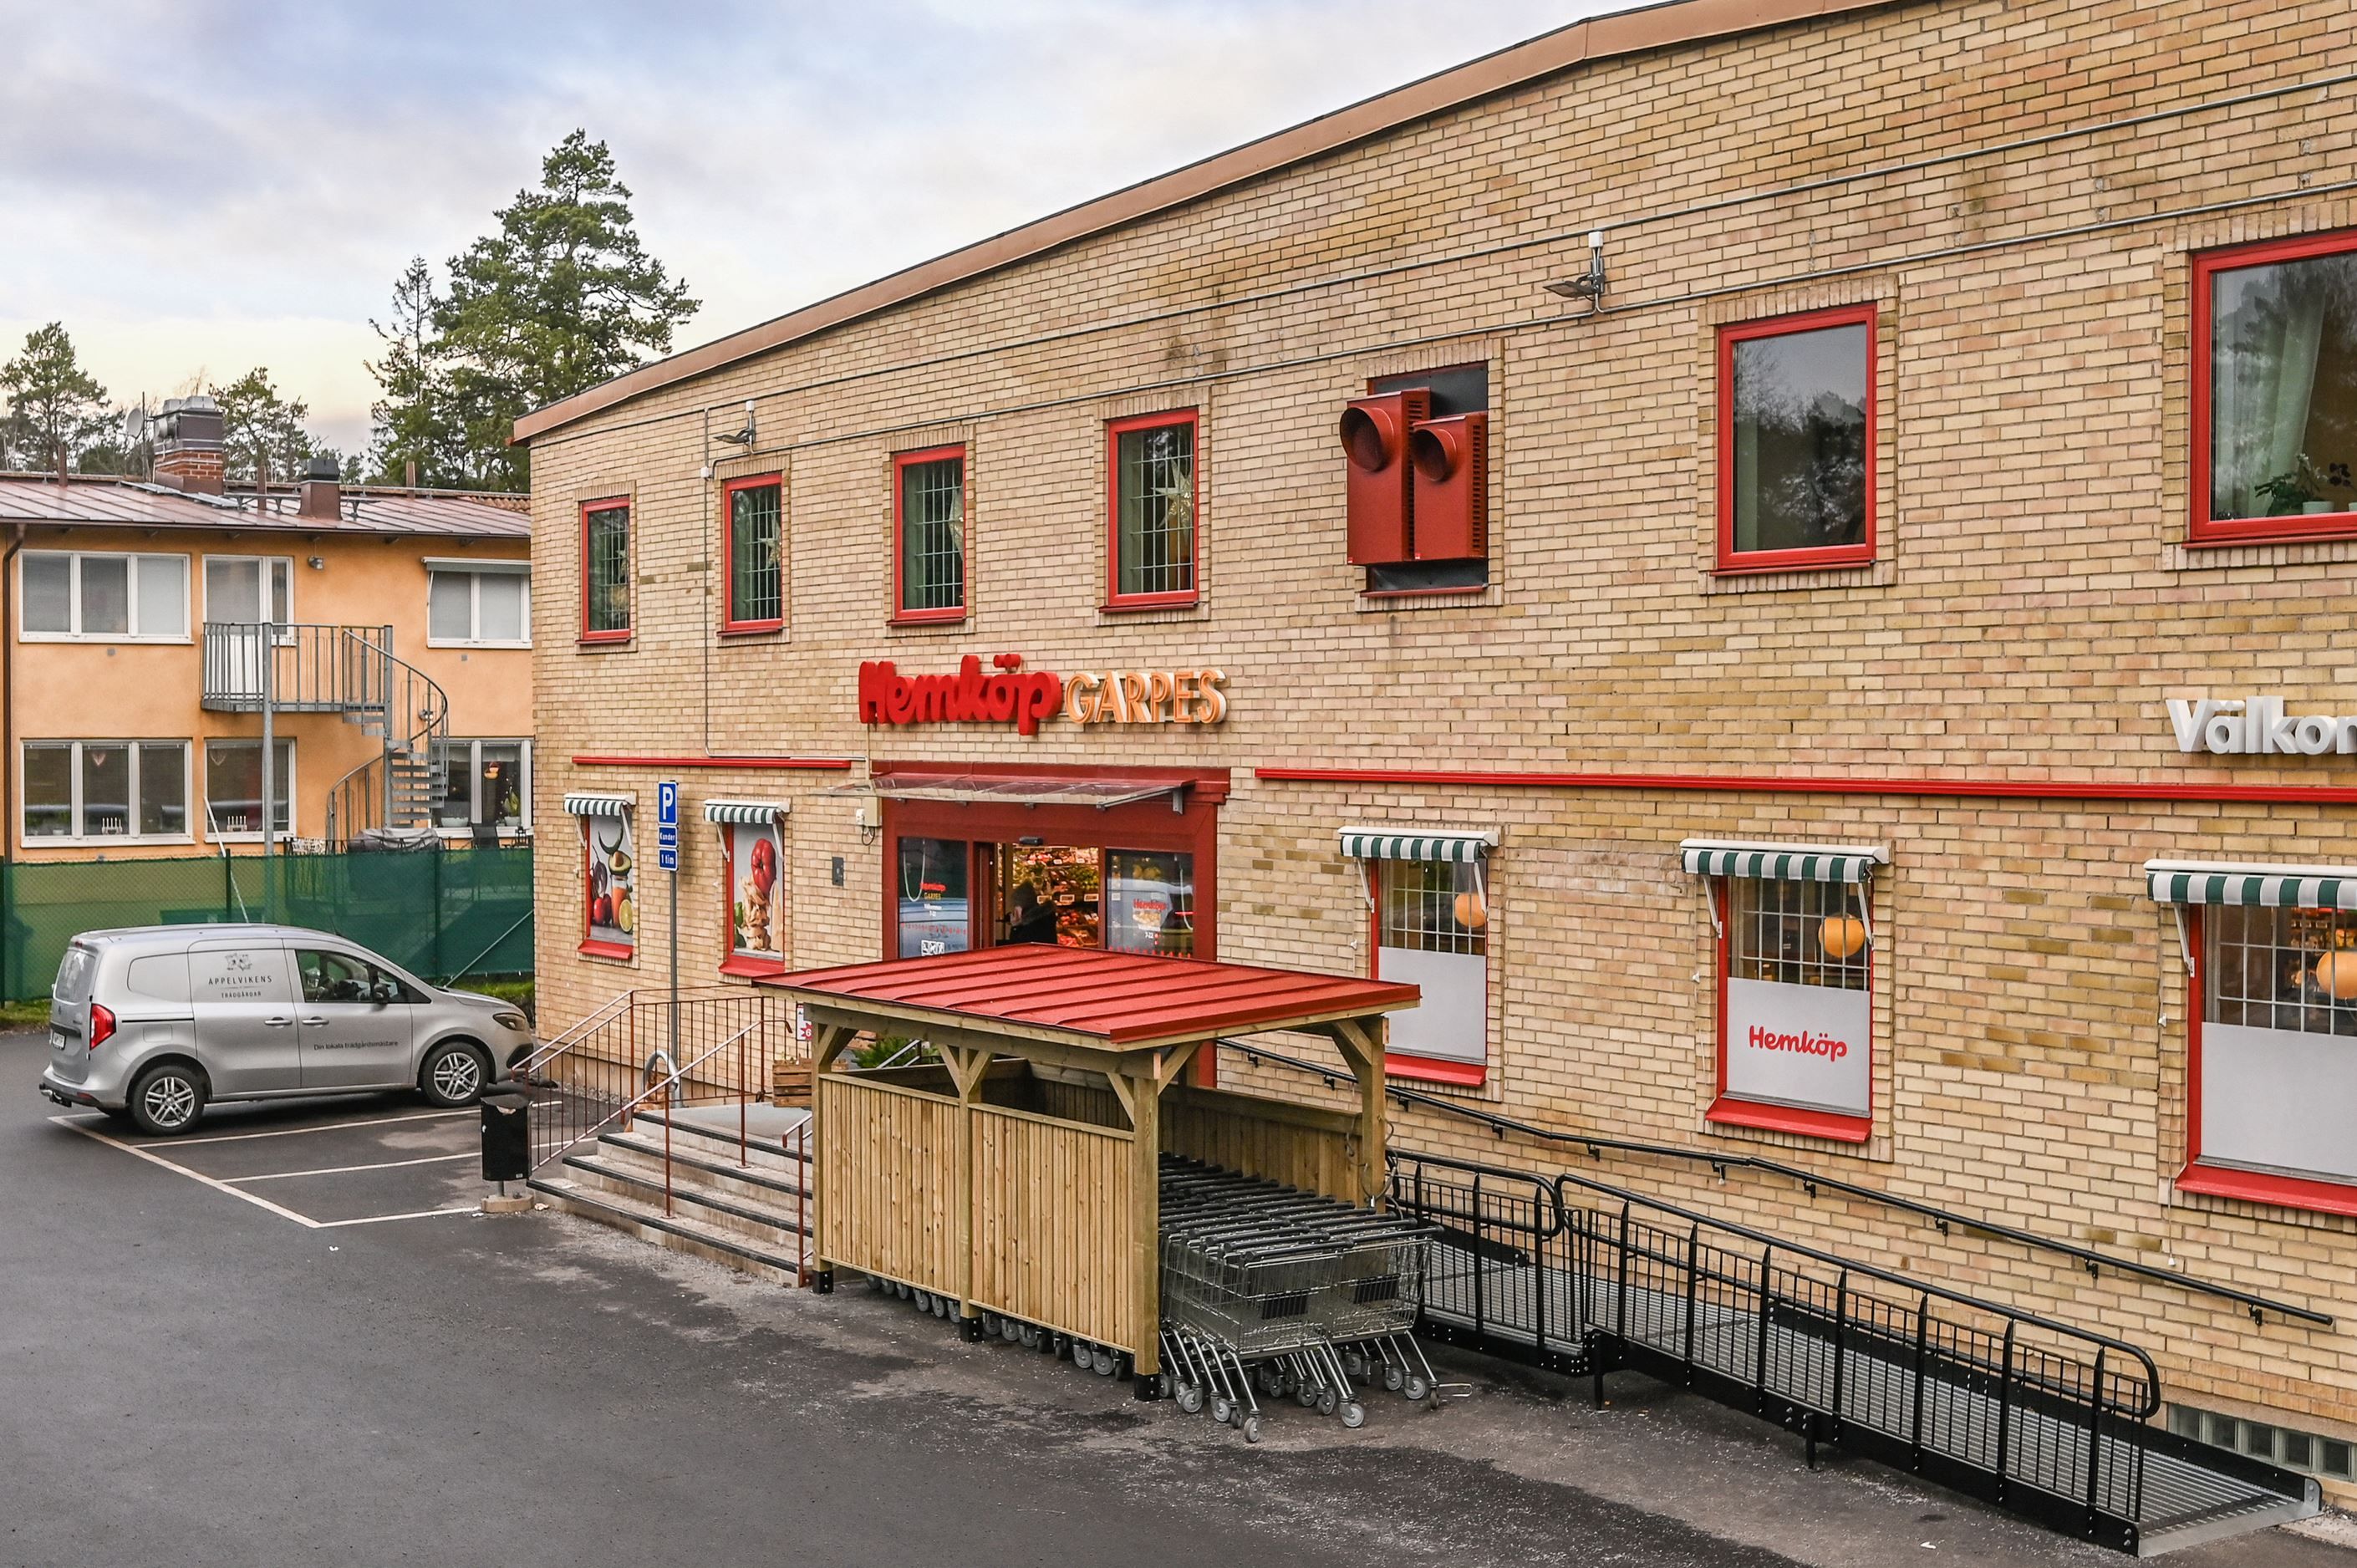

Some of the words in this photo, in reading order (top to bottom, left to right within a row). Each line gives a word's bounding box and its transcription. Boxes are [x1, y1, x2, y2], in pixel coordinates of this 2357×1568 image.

[858, 654, 1061, 736] Hemköp
[1066, 669, 1226, 724] GARPES
[663, 787, 673, 820] P
[659, 832, 675, 841] Kunder
[665, 855, 675, 865] tim
[1749, 1025, 1847, 1062] Hemköp
